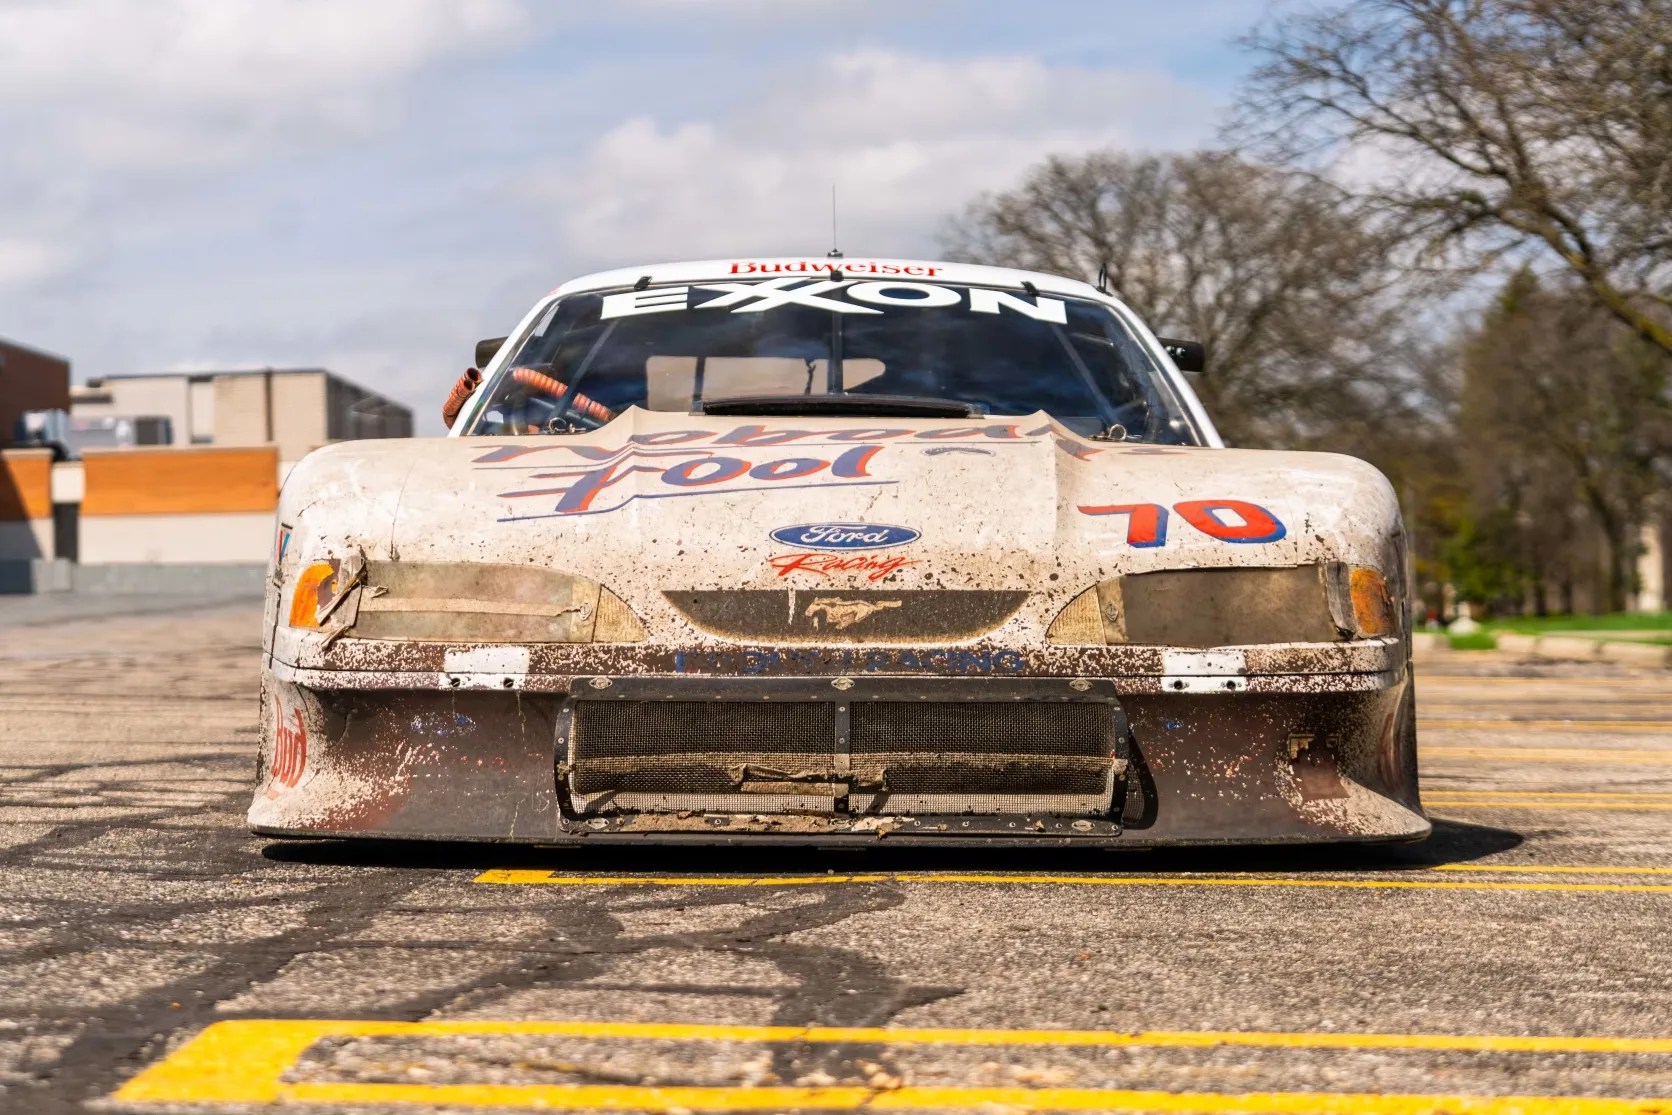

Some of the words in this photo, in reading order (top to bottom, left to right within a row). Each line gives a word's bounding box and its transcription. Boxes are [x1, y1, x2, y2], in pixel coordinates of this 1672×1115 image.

[728, 261, 944, 277] Budweiser
[600, 277, 1068, 324] EXXON
[1077, 499, 1288, 549] 70
[768, 552, 922, 581] Racing
